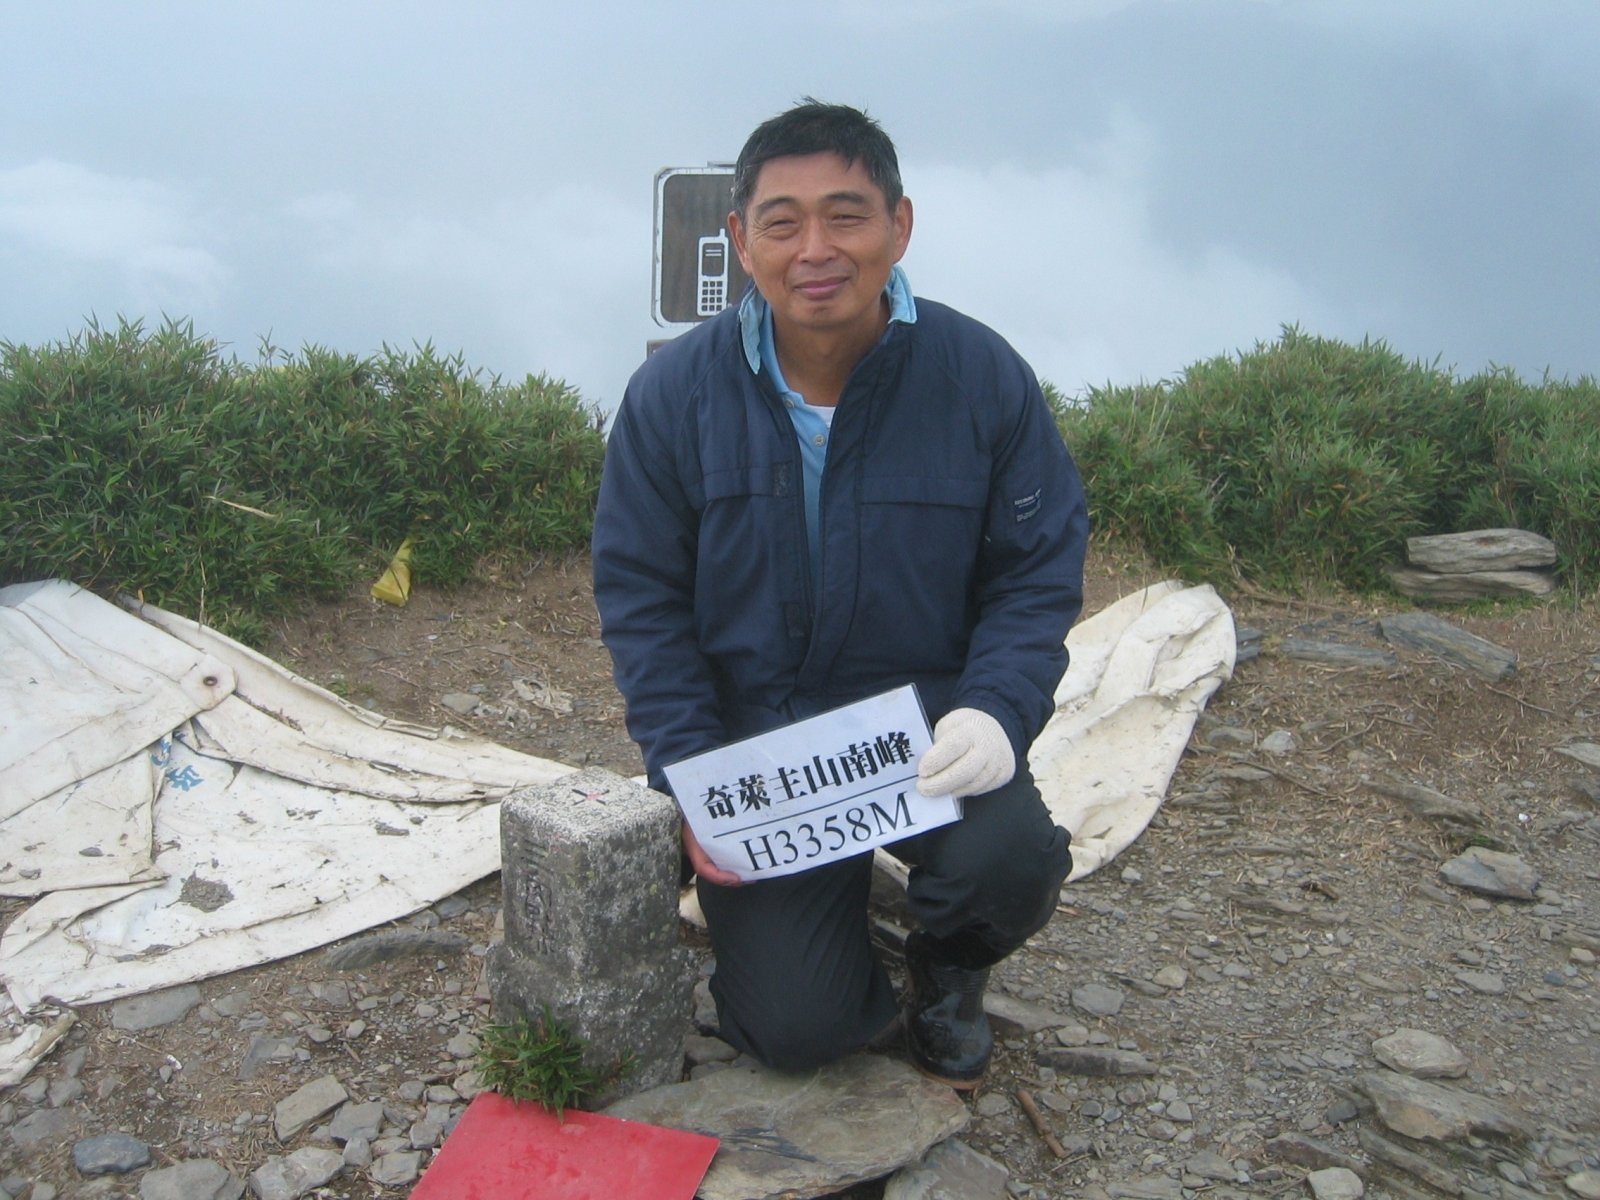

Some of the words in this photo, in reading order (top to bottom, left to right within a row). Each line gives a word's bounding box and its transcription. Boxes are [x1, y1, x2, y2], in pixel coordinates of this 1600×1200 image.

[700, 731, 915, 819] 奇萊主山南峰
[740, 791, 917, 871] H3358M
